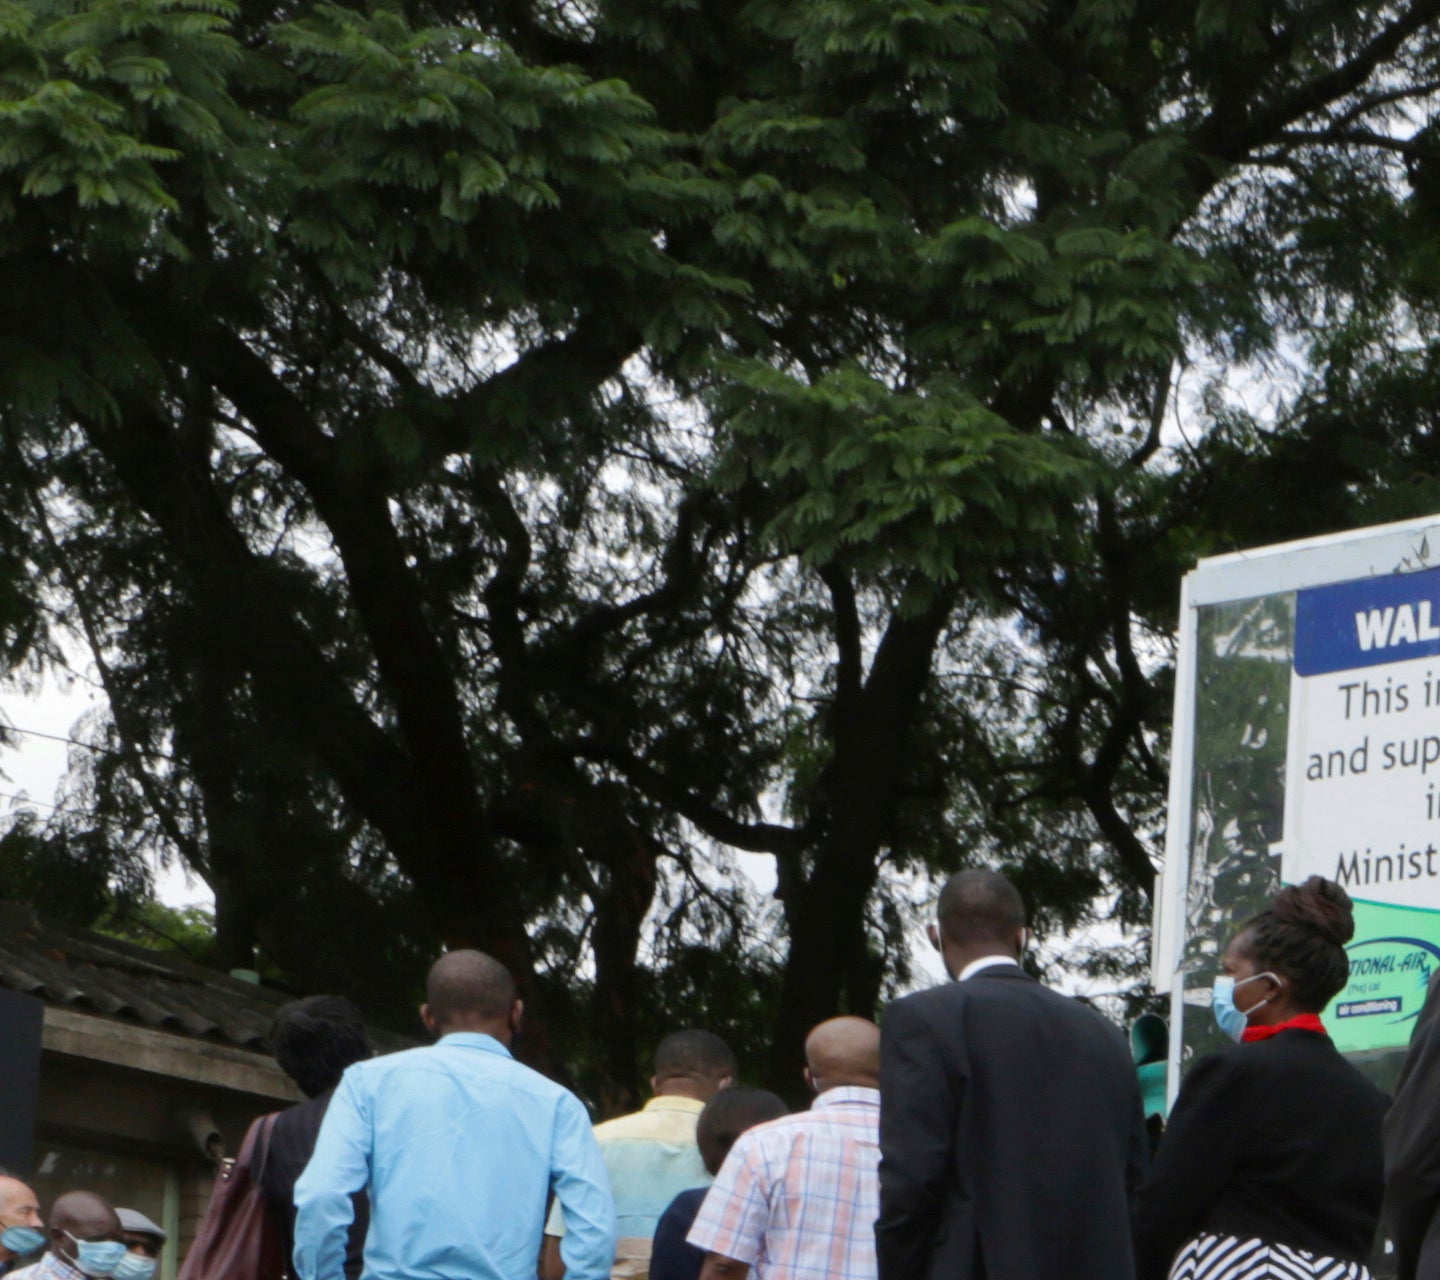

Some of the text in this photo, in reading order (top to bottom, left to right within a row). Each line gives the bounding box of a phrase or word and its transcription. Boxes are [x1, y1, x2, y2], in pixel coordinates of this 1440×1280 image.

[1339, 682, 1409, 719] This
[1306, 737, 1369, 781] and
[1350, 951, 1428, 976] TIONAL-AIR
